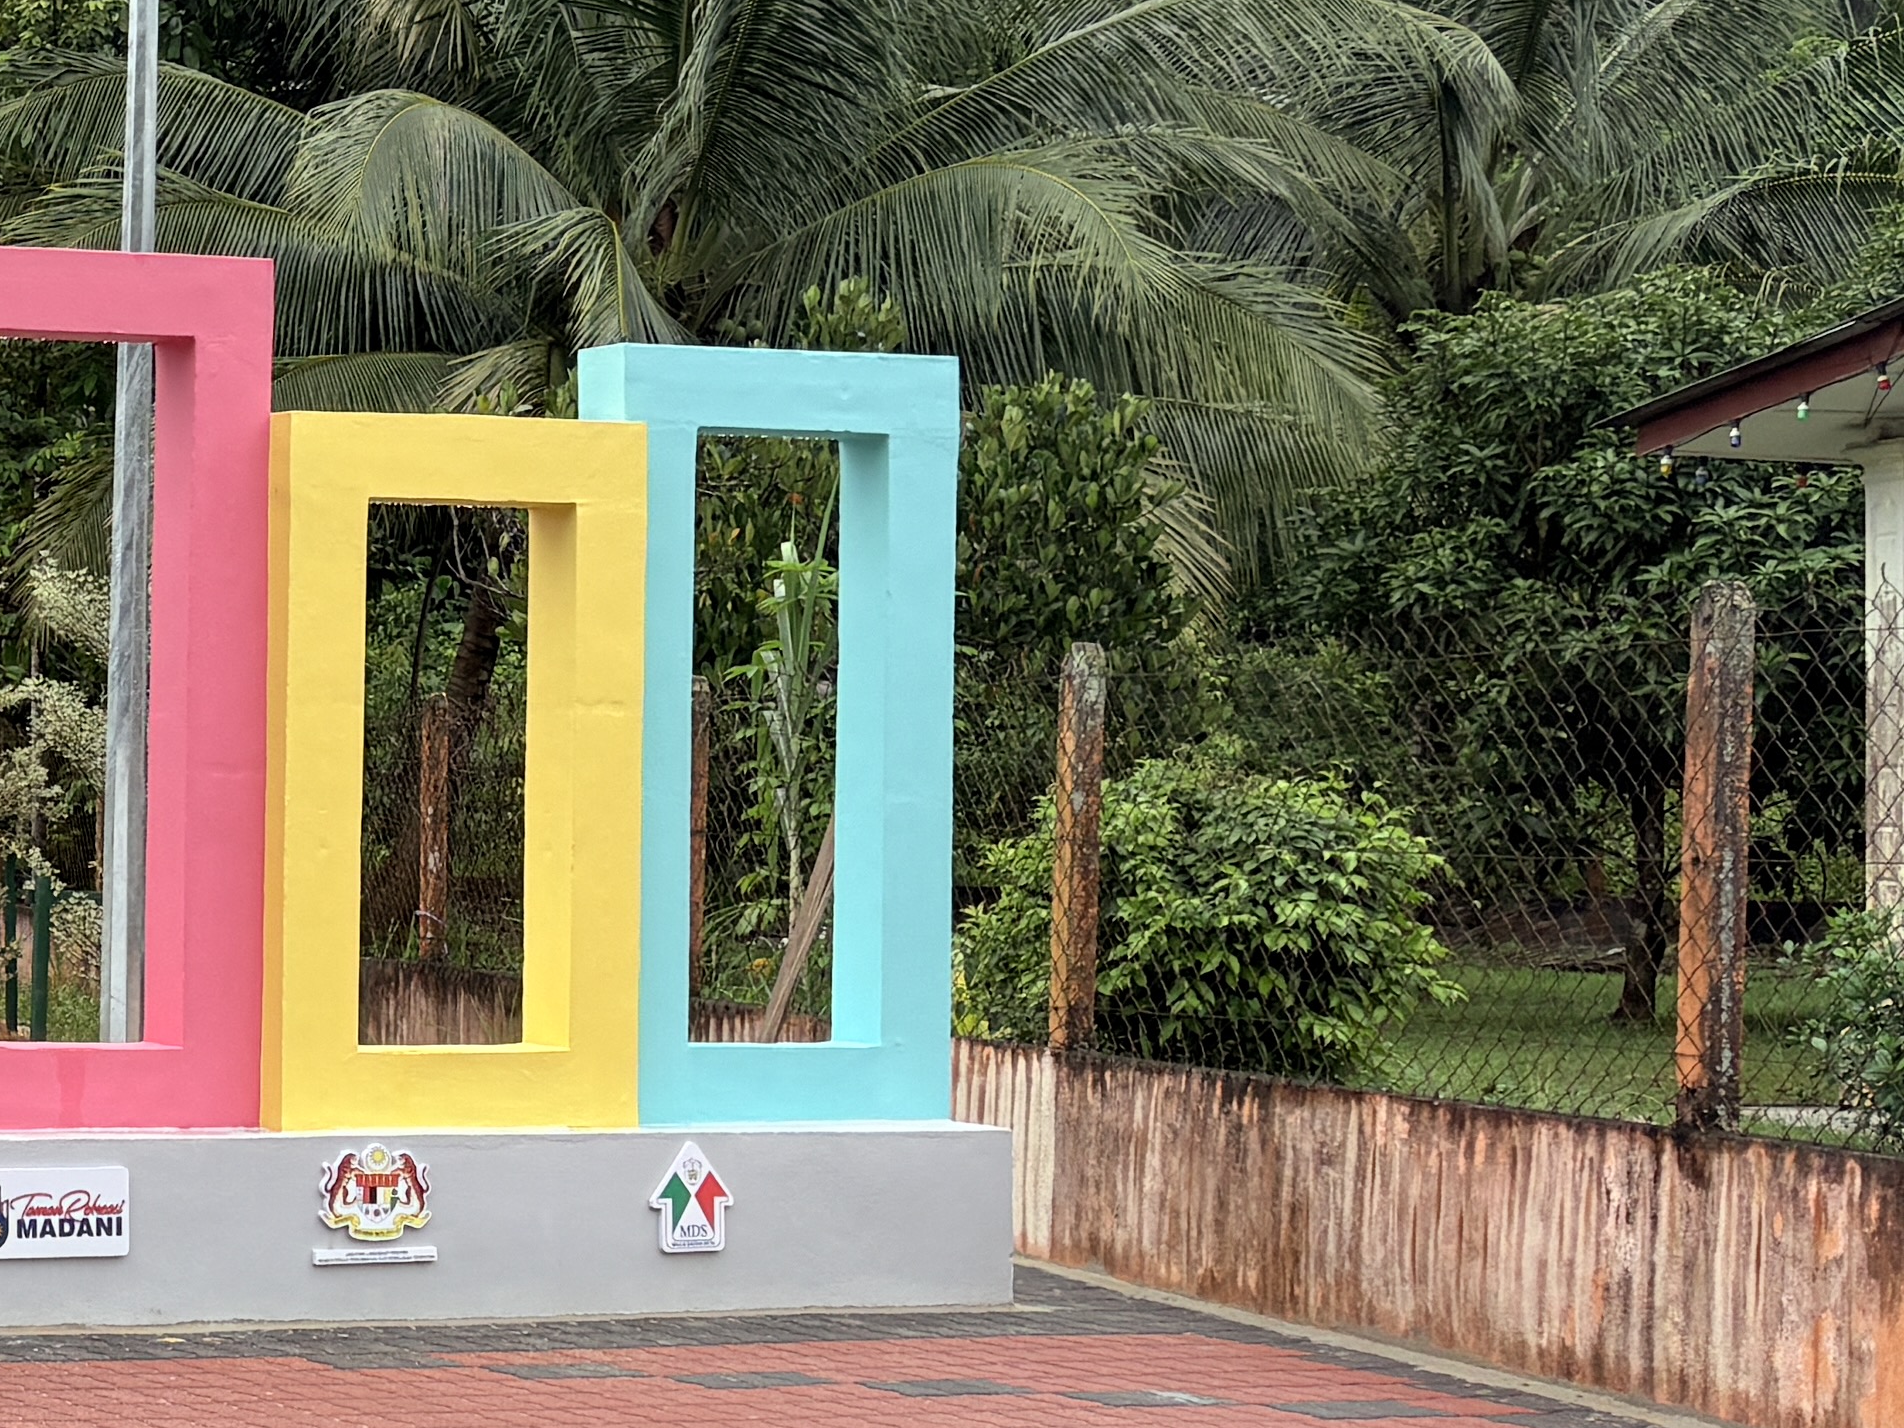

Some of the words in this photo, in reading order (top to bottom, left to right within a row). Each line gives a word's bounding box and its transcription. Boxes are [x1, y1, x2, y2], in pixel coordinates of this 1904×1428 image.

[10, 1192, 64, 1220] Taman
[16, 1216, 123, 1239] MADANI
[680, 1224, 708, 1238] MDS
